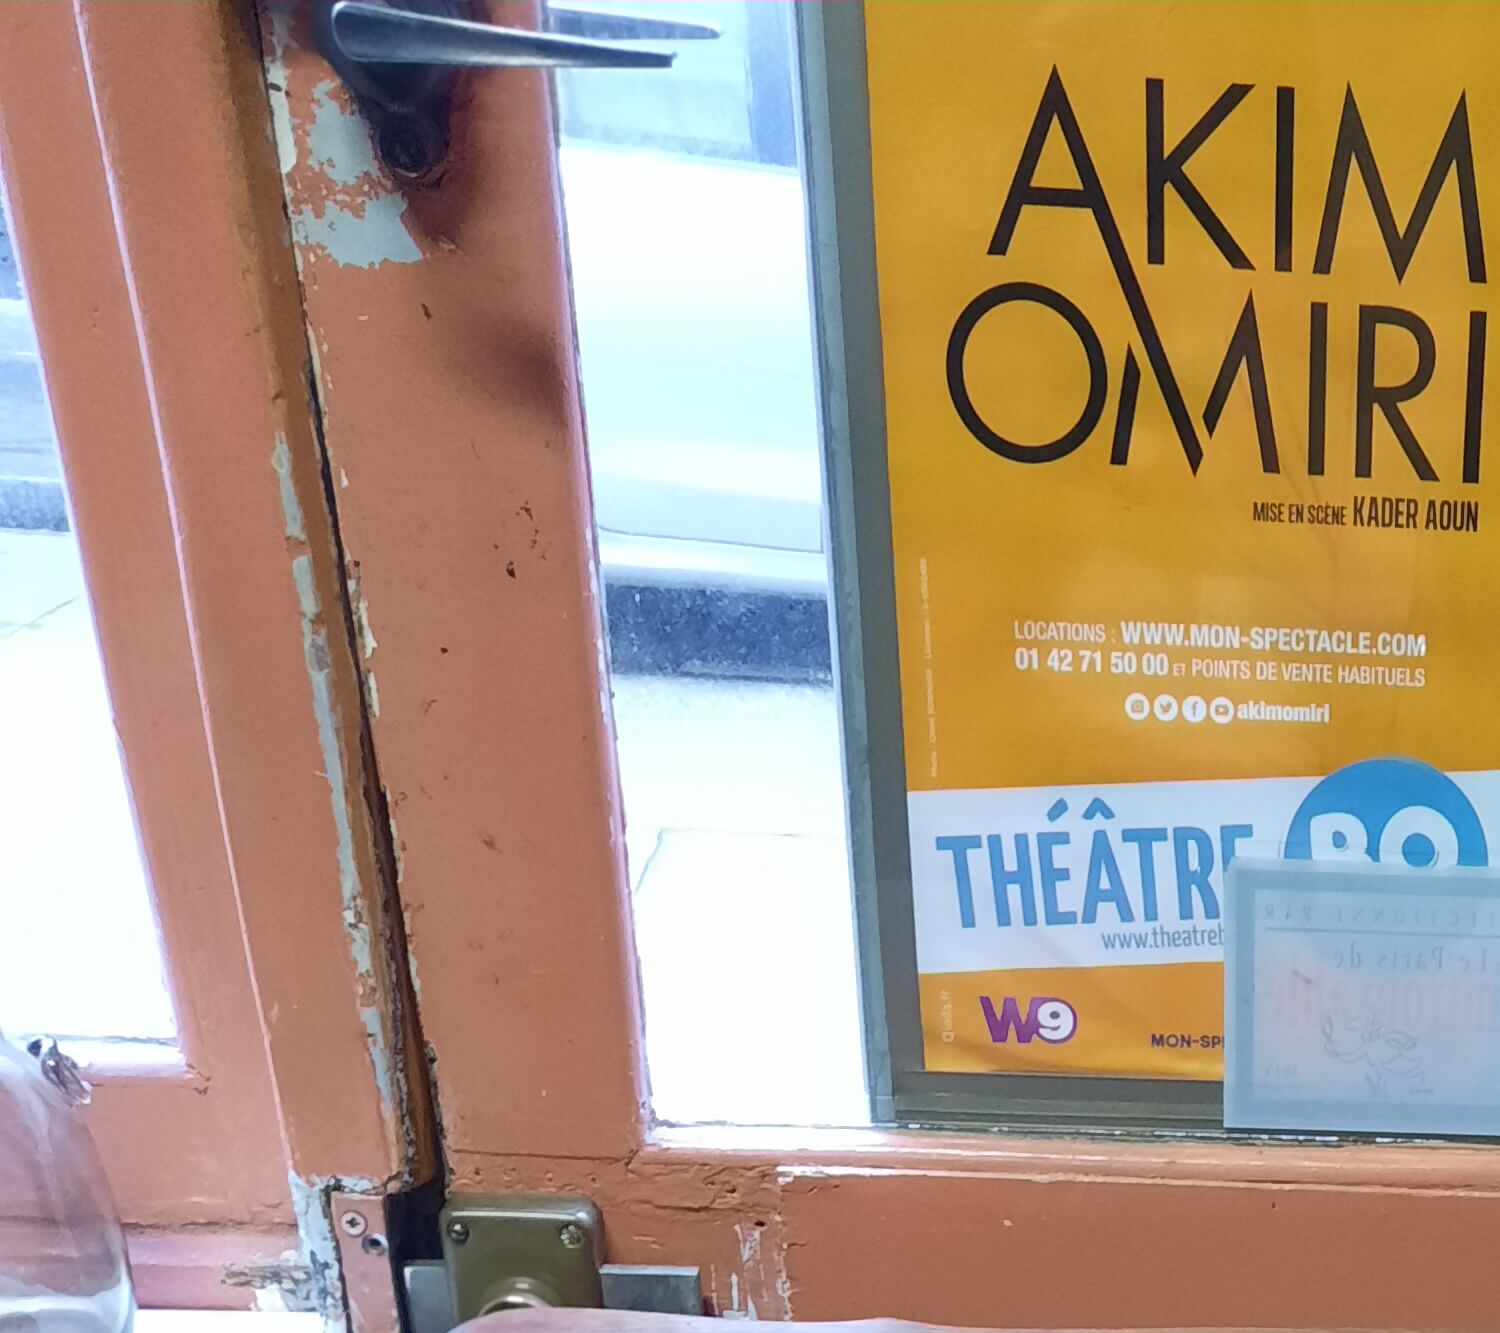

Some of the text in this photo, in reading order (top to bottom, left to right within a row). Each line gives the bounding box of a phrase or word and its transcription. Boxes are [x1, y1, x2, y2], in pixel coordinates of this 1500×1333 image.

[987, 63, 1488, 285] AKIM
[945, 281, 1487, 484] OMIRI
[1252, 495, 1479, 532] MISE EN SCÈNE KADER AOUN
[1014, 620, 1106, 643] LOCATIONS
[1120, 621, 1426, 656] WWW.MON-SPECTACLE.COM
[1015, 647, 1426, 688] 01 42 71 50 00 ET POINTS DE VENTE HABITUELS
[1237, 700, 1330, 723] akimomiri
[980, 995, 1077, 1044] W9
